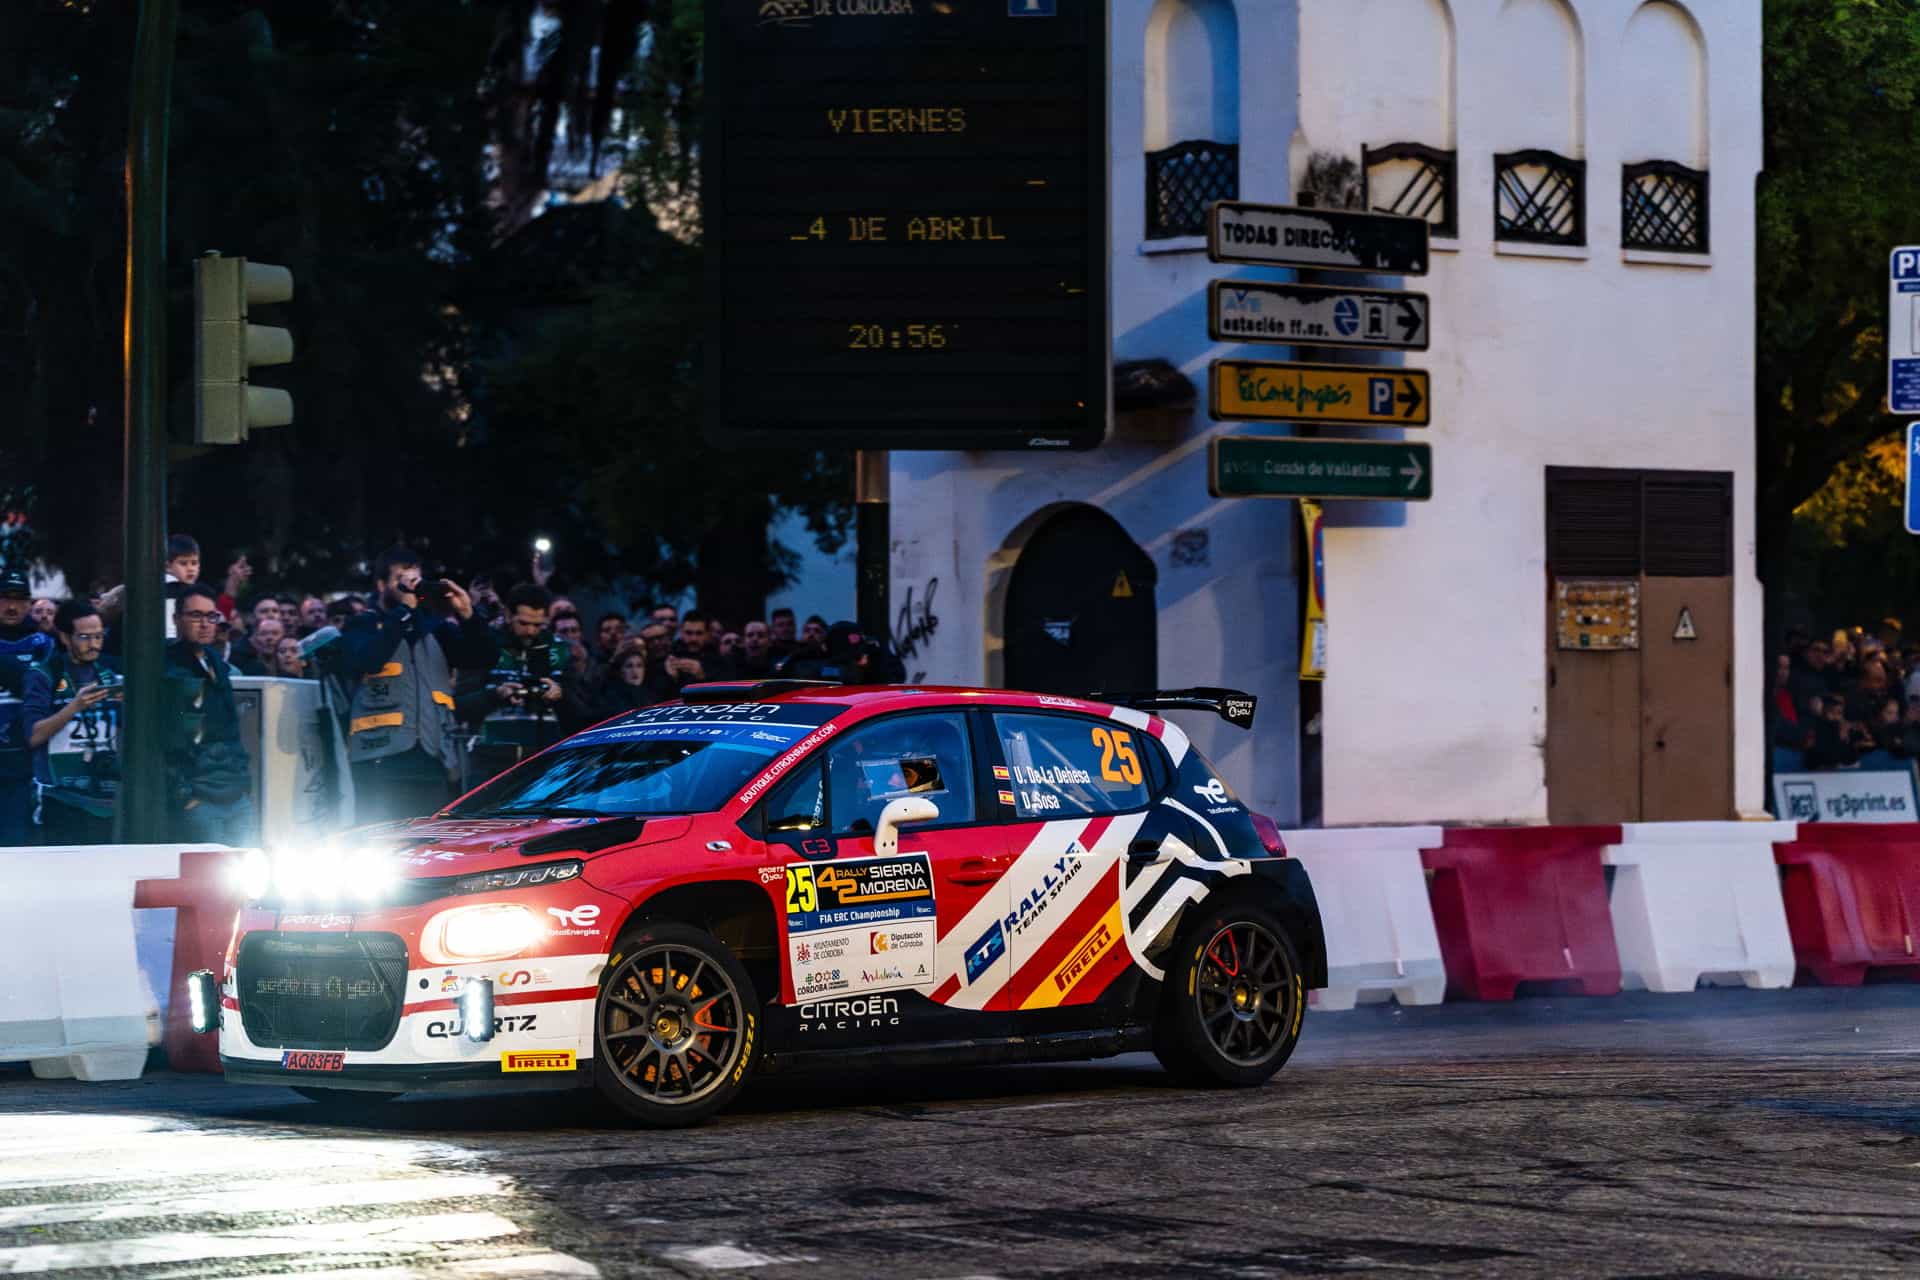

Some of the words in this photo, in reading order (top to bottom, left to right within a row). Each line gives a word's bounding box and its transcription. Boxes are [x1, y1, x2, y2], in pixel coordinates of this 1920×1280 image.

[828, 109, 967, 134] VIERNES
[849, 217, 888, 241] DE
[907, 217, 1006, 241] ABRIL
[1224, 223, 1278, 247] TODAS
[848, 325, 947, 349] 20:56
[1374, 381, 1391, 412] P
[1091, 727, 1143, 784] 25
[1054, 767, 1091, 784] Dehesa
[802, 839, 831, 856] C3
[836, 867, 867, 879] RALLY
[870, 862, 925, 879] SIERRA
[786, 867, 816, 914] 25
[860, 877, 928, 896] MORENA
[819, 912, 833, 925] FIA
[834, 910, 849, 923] ERC
[850, 907, 901, 921] Championship
[1053, 922, 1112, 993] PIRELLI
[508, 1053, 570, 1068] PIRELLI
